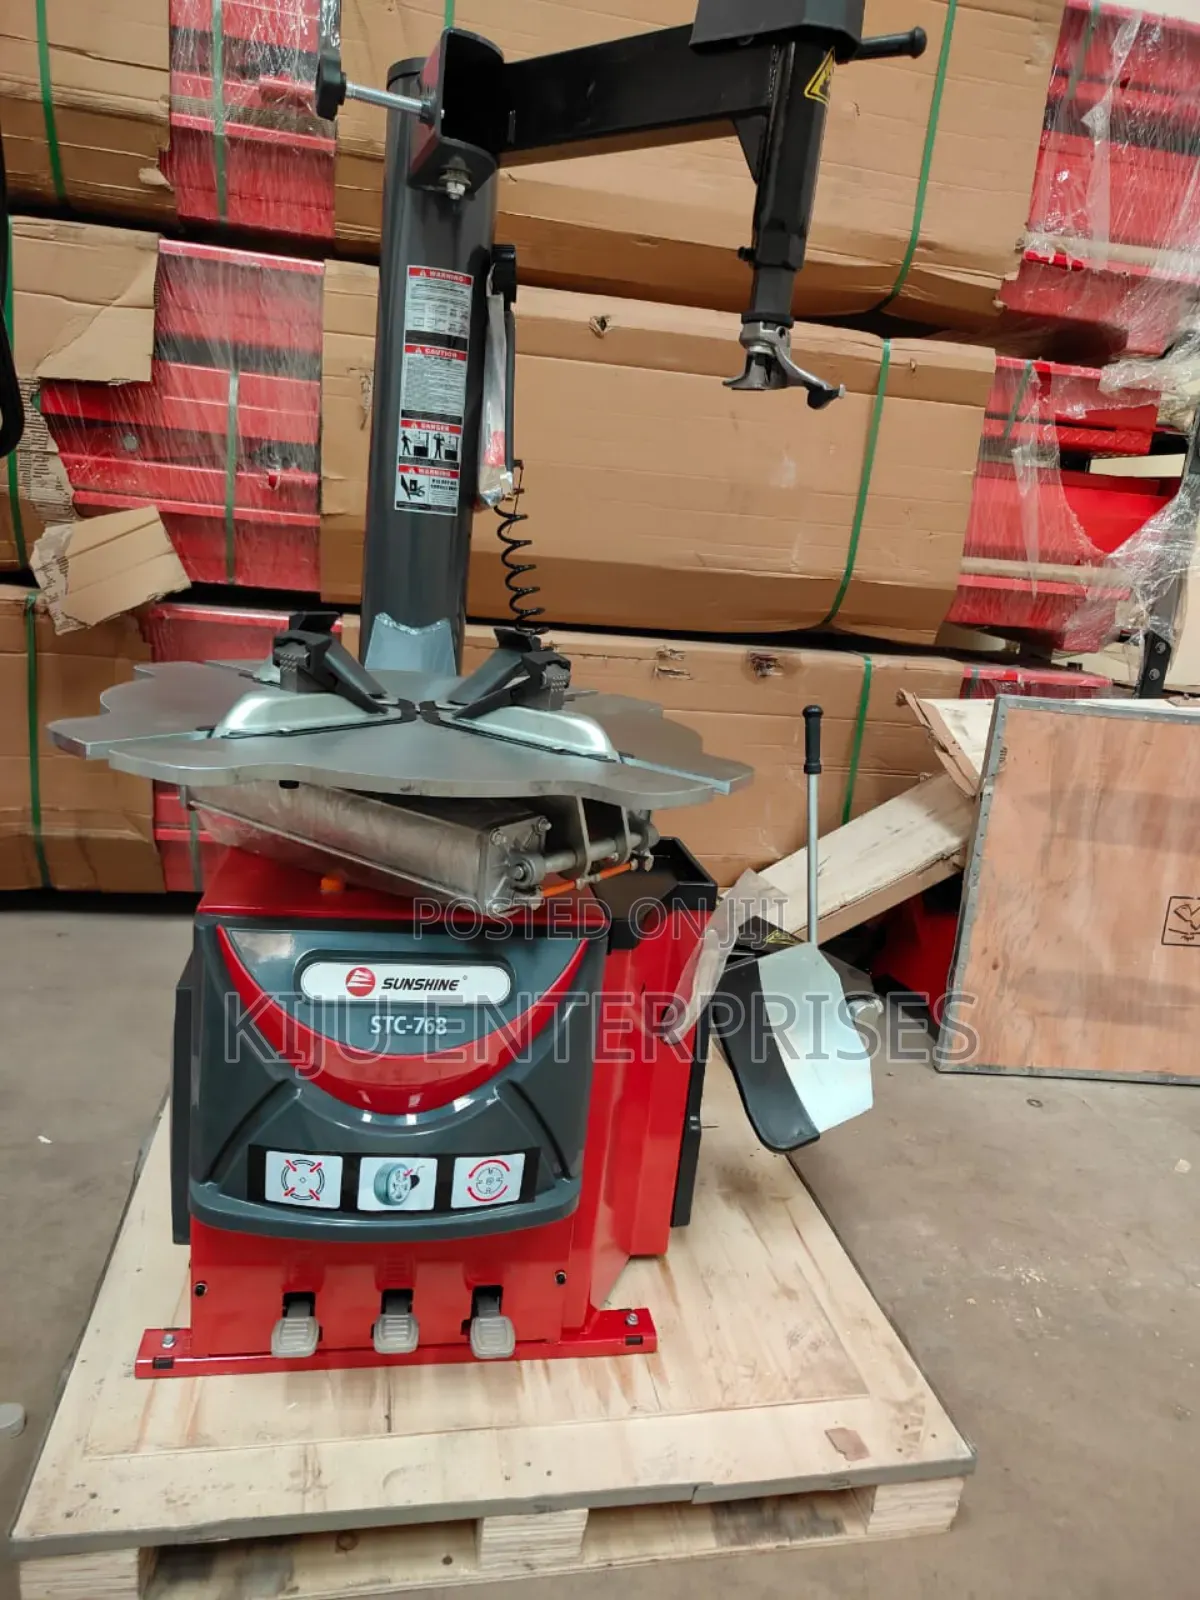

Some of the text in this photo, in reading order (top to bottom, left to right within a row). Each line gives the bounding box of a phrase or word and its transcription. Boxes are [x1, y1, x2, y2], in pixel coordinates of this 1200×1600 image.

[429, 270, 465, 282] WARNING
[424, 348, 458, 358] CAUTION
[420, 423, 450, 432] DANGER
[381, 978, 460, 991] SUNSHINE
[370, 1015, 447, 1035] STC-768
